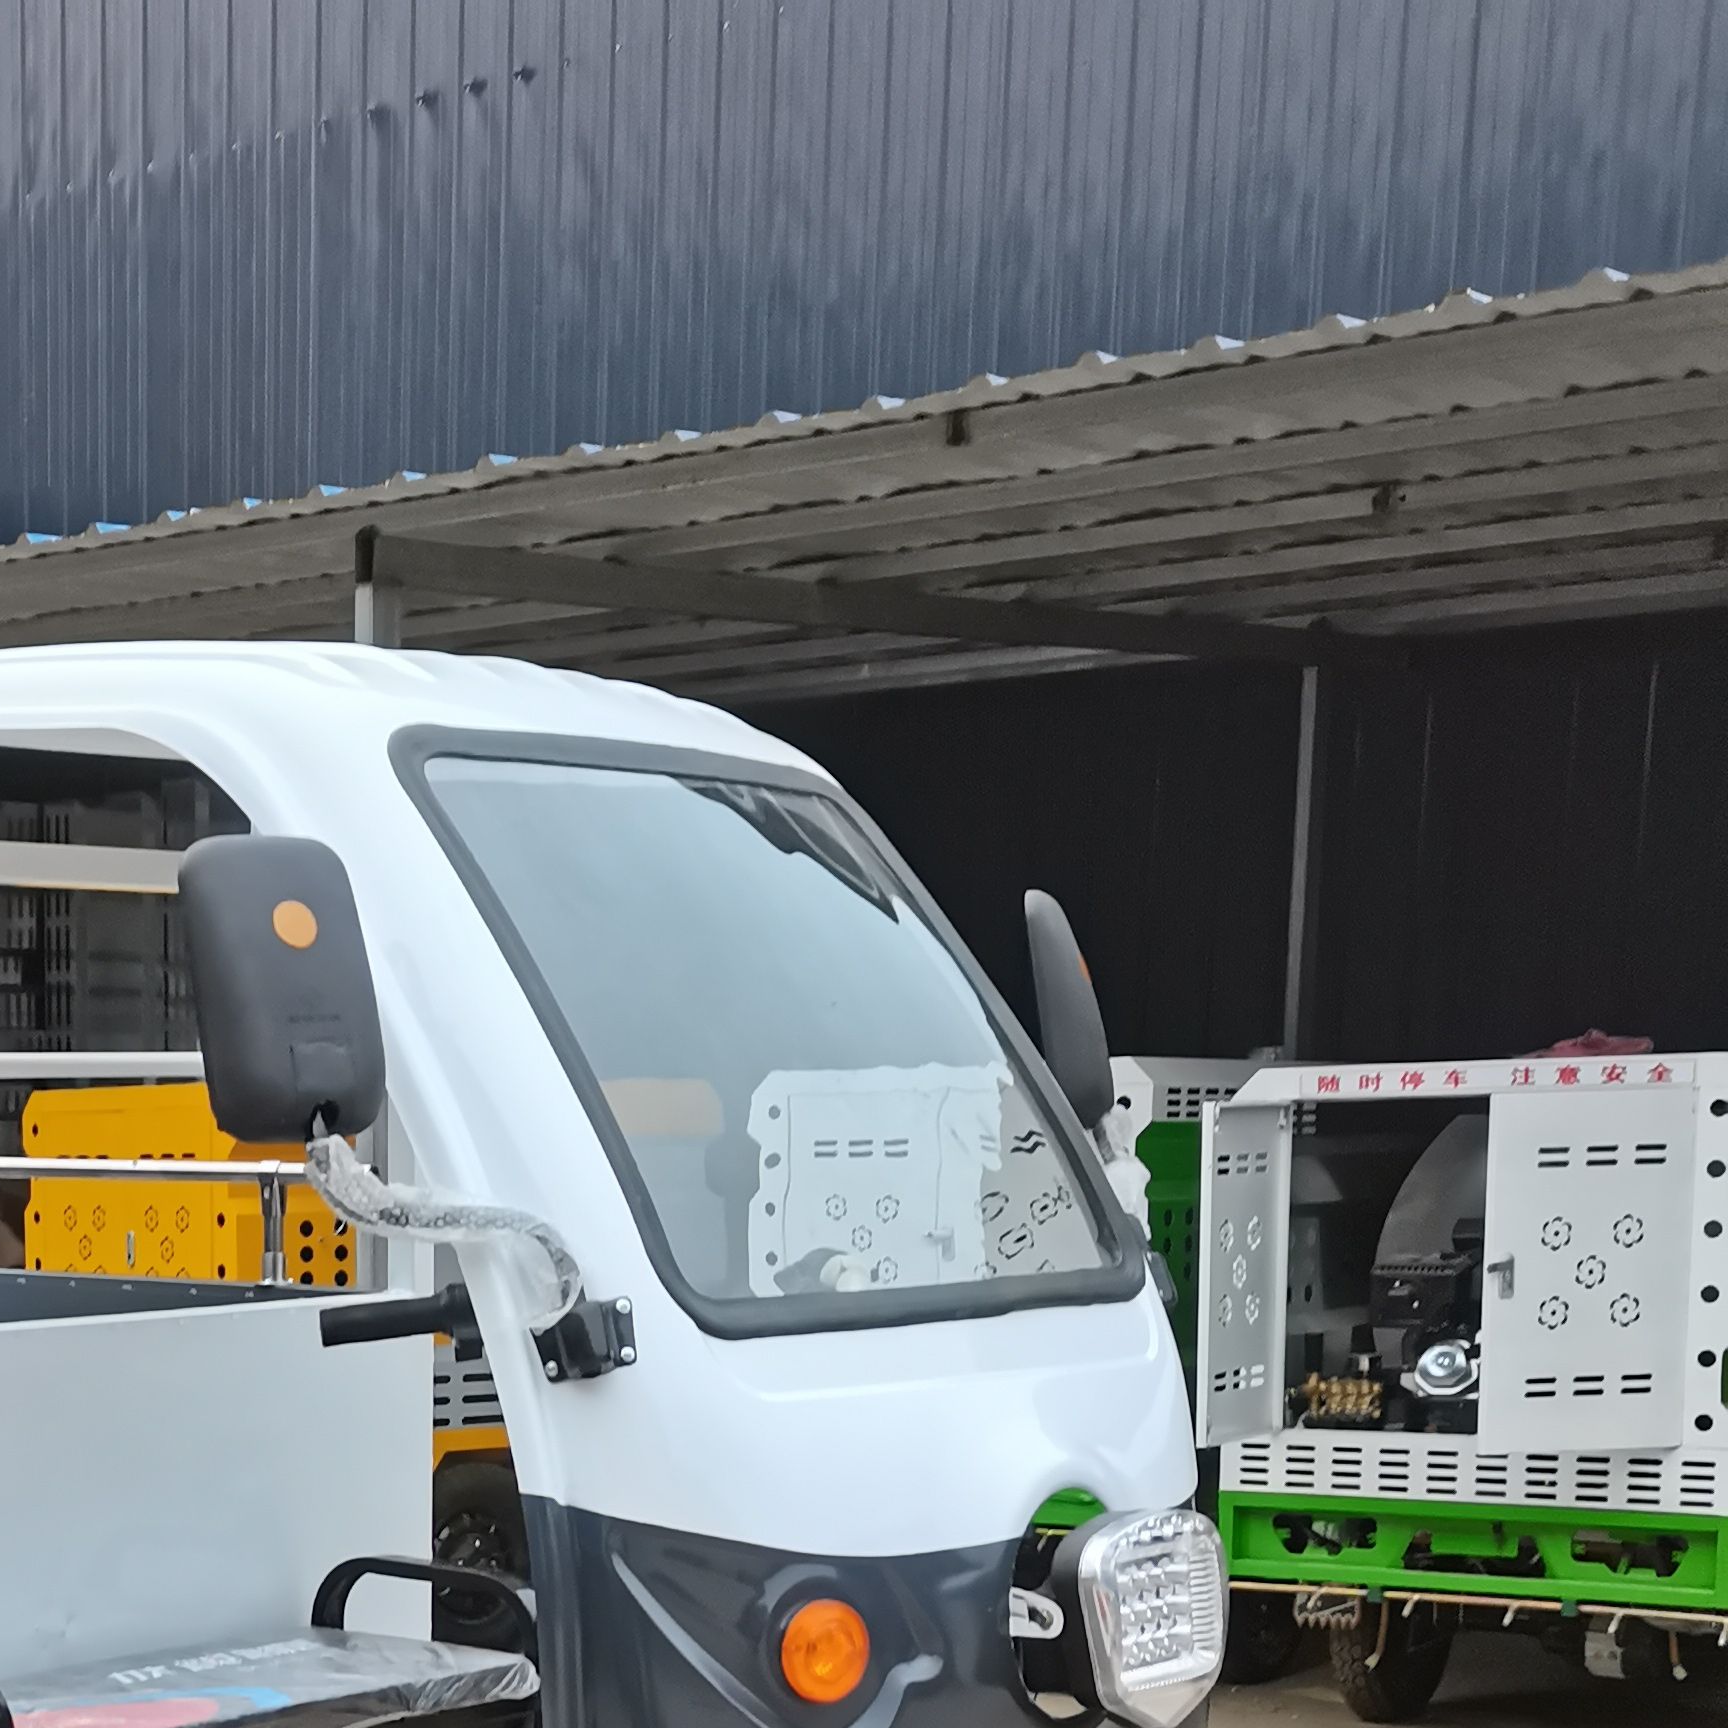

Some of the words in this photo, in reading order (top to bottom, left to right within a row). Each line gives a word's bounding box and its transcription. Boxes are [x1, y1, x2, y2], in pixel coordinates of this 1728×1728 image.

[1317, 1068, 1468, 1094] 随时停车
[1510, 1062, 1674, 1087] 注意安全
